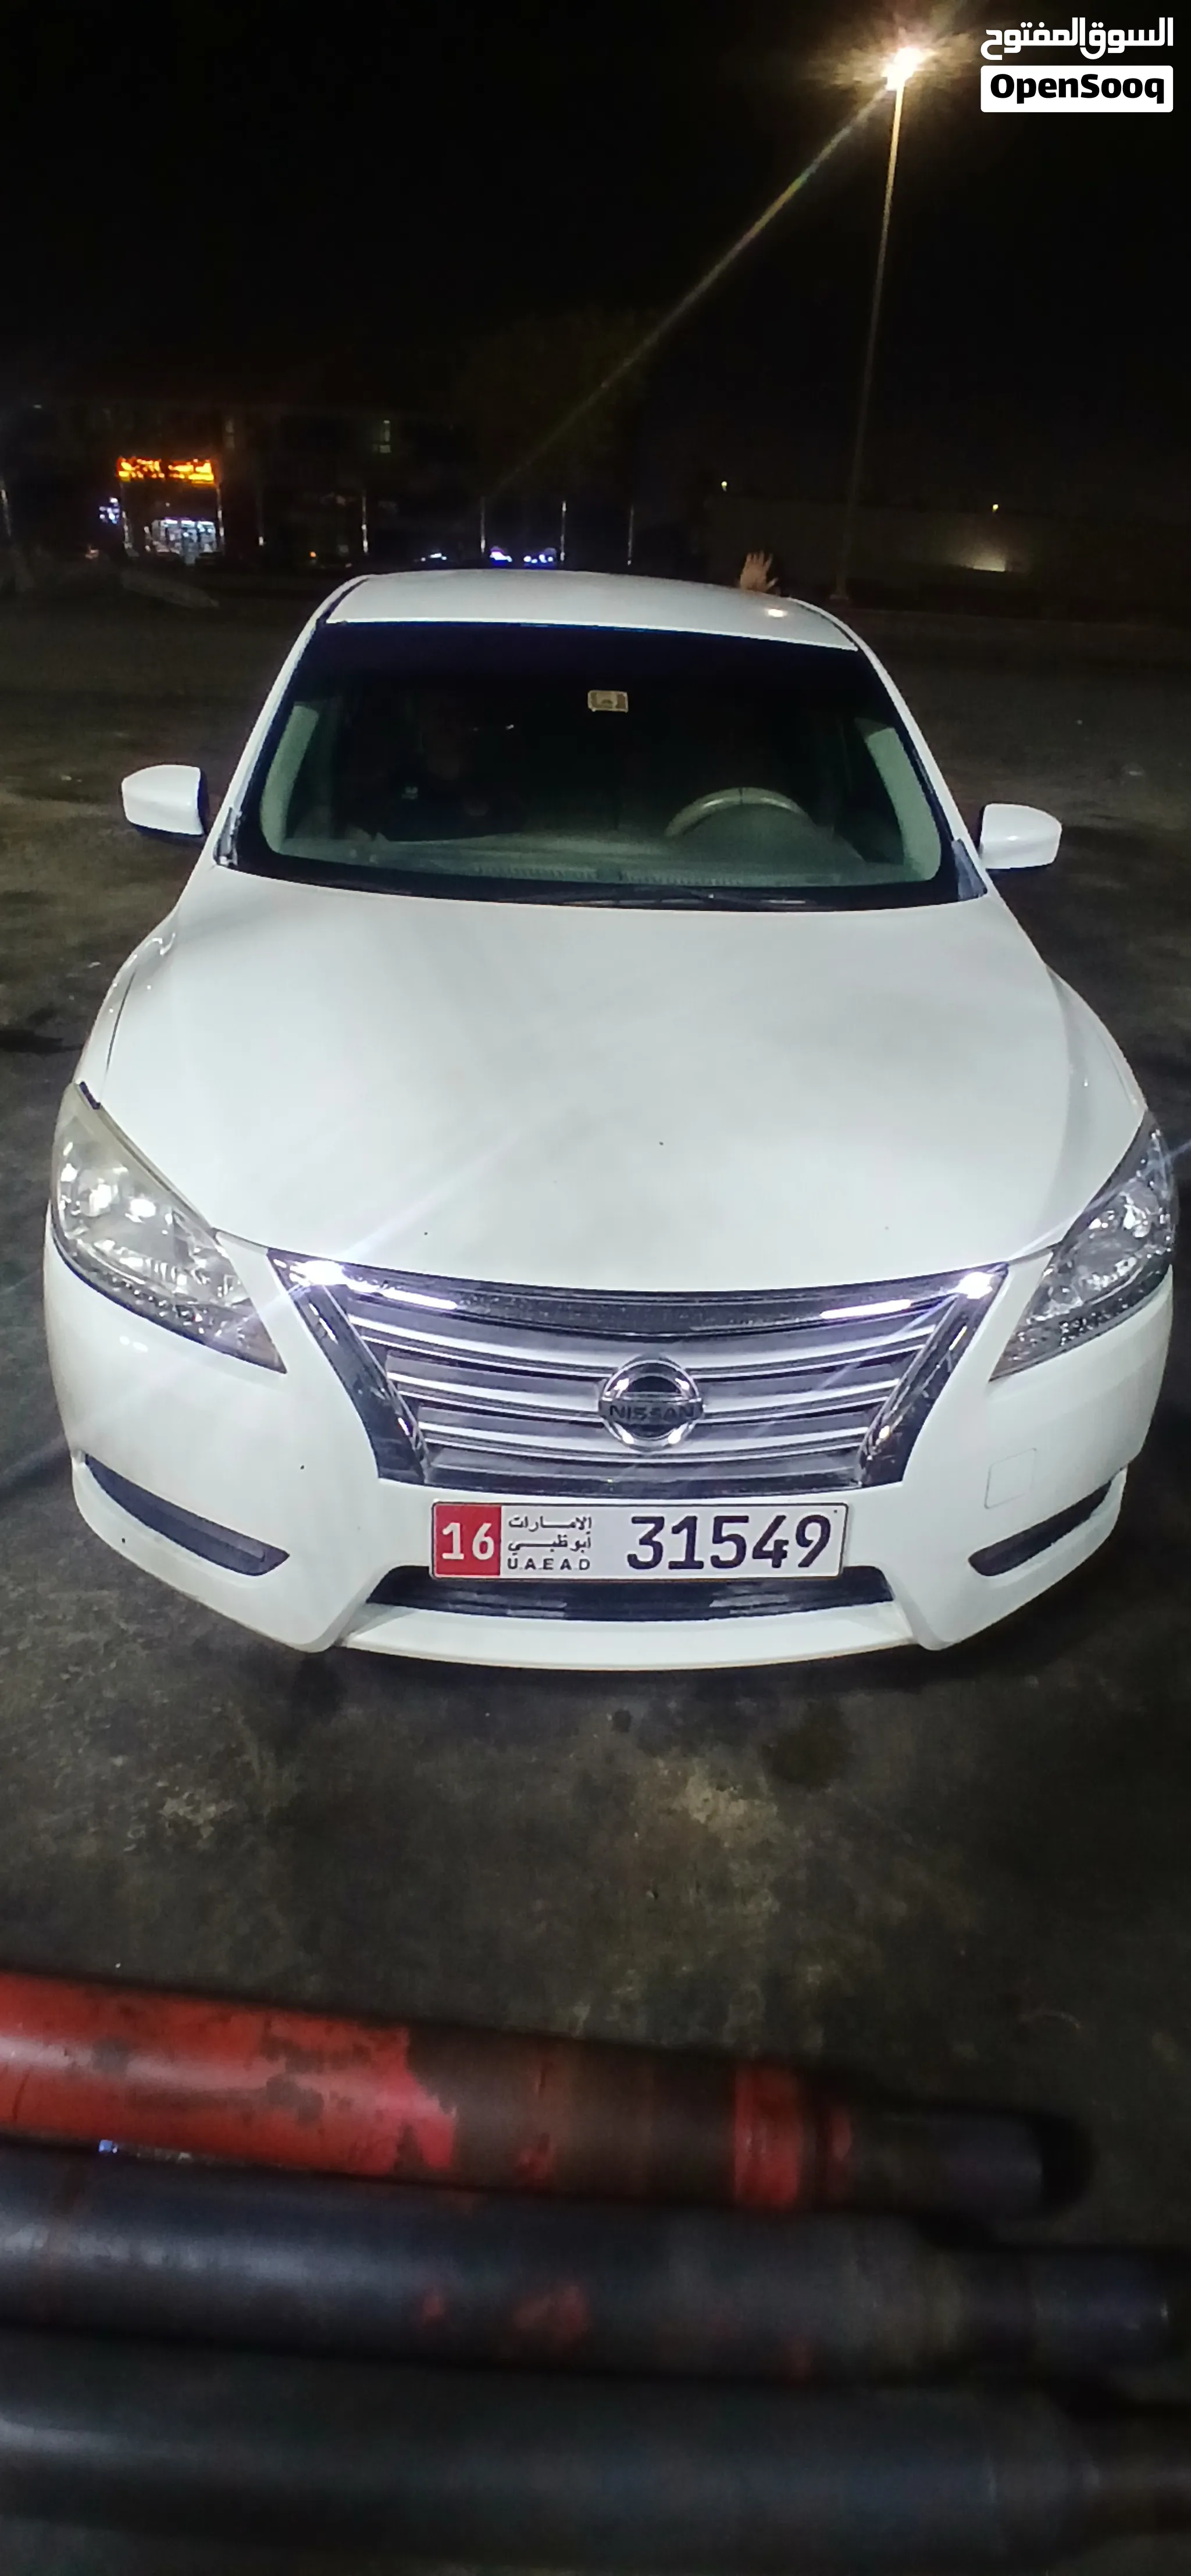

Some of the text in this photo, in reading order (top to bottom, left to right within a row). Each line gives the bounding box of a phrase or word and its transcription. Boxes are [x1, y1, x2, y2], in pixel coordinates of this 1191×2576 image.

[609, 1404, 695, 1421] NISSAN
[441, 1522, 494, 1561] 16
[627, 1514, 831, 1570] 31549
